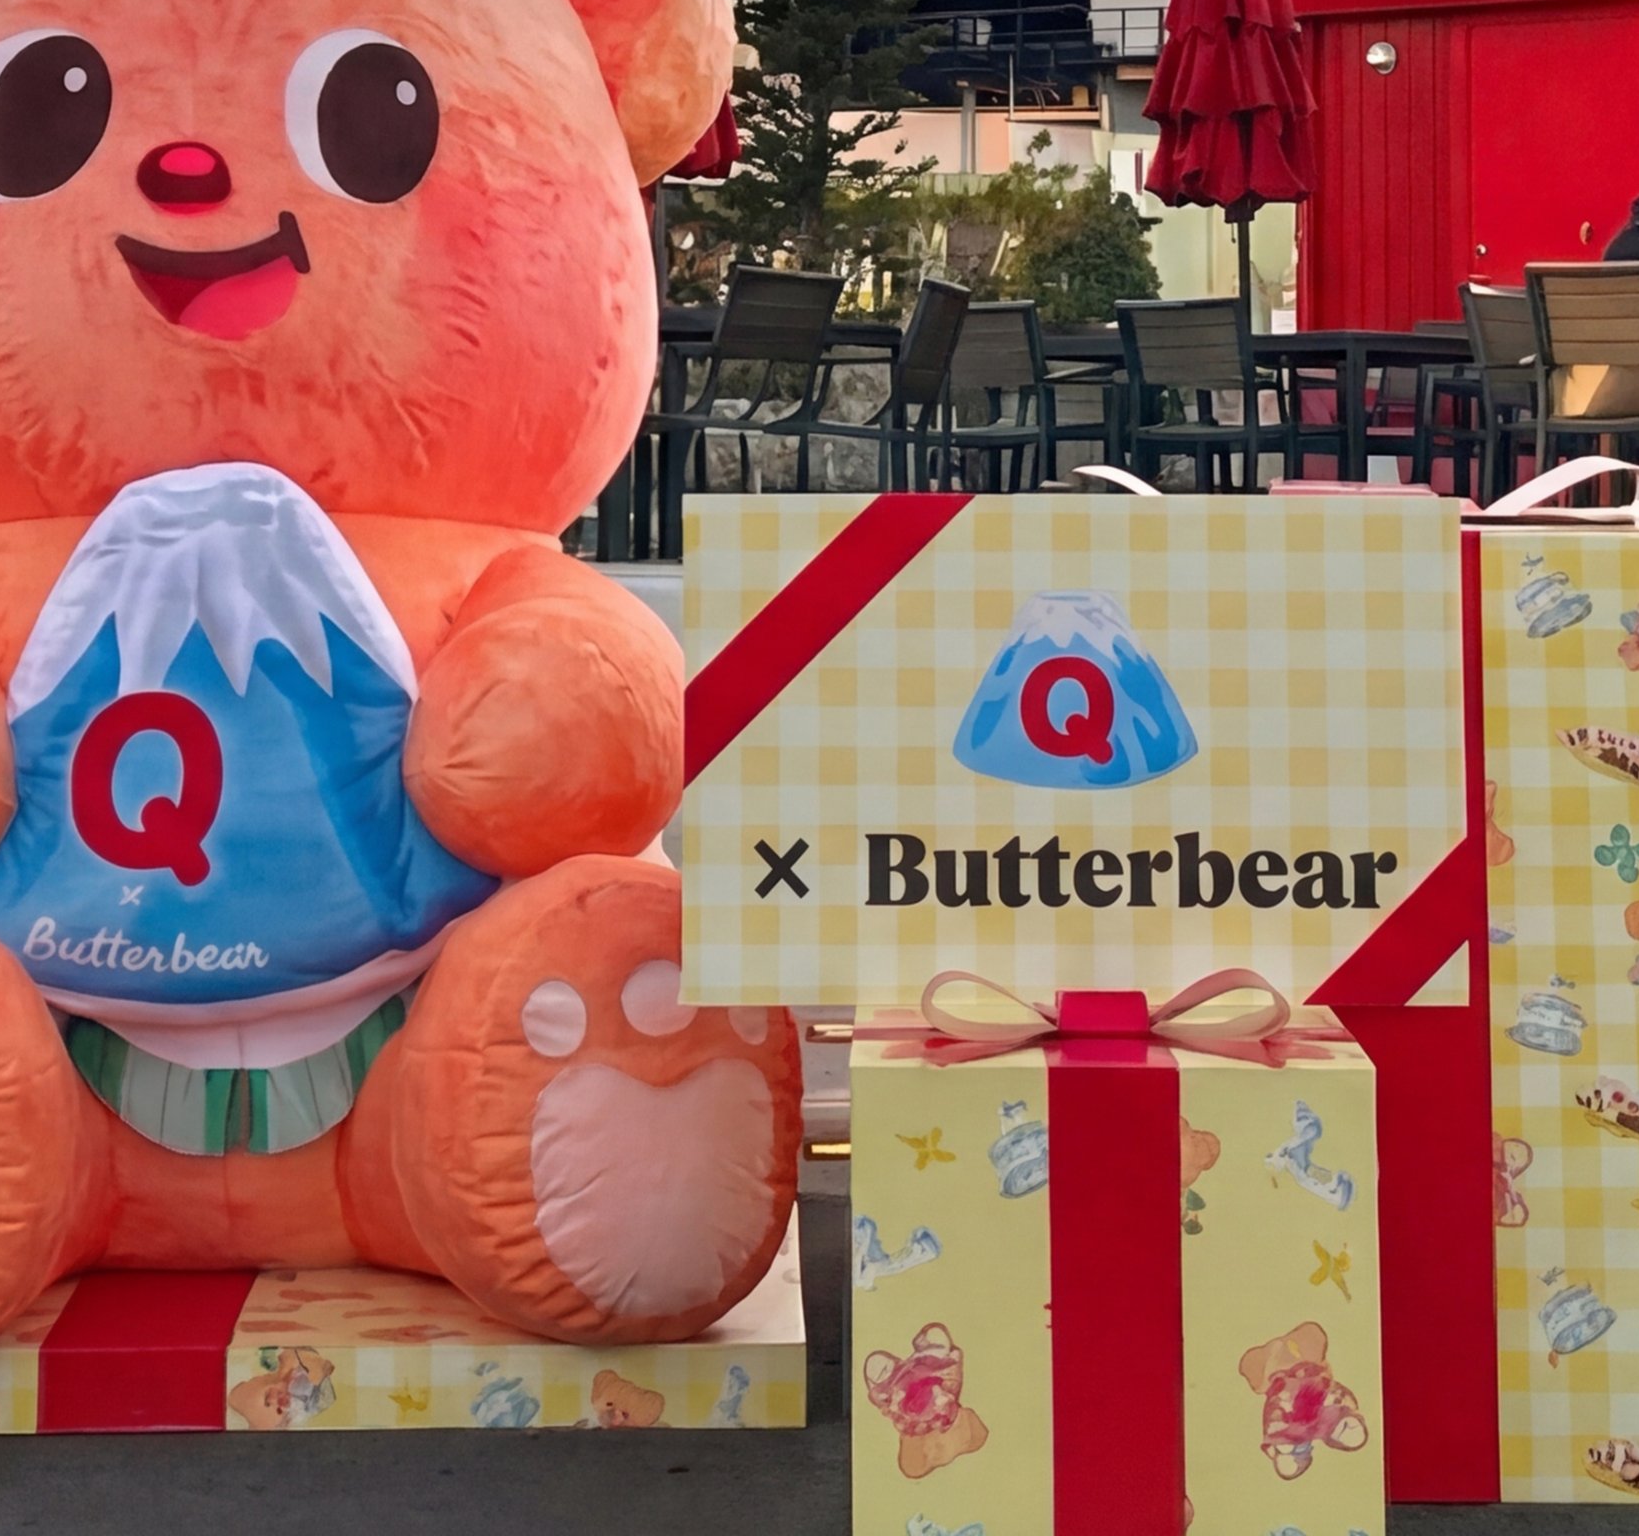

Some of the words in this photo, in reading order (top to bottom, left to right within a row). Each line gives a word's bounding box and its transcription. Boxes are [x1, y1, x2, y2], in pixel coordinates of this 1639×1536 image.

[1020, 656, 1116, 766] Q
[71, 691, 223, 887] Q
[865, 831, 1397, 910] Butterbear
[23, 915, 269, 974] Butterbear
